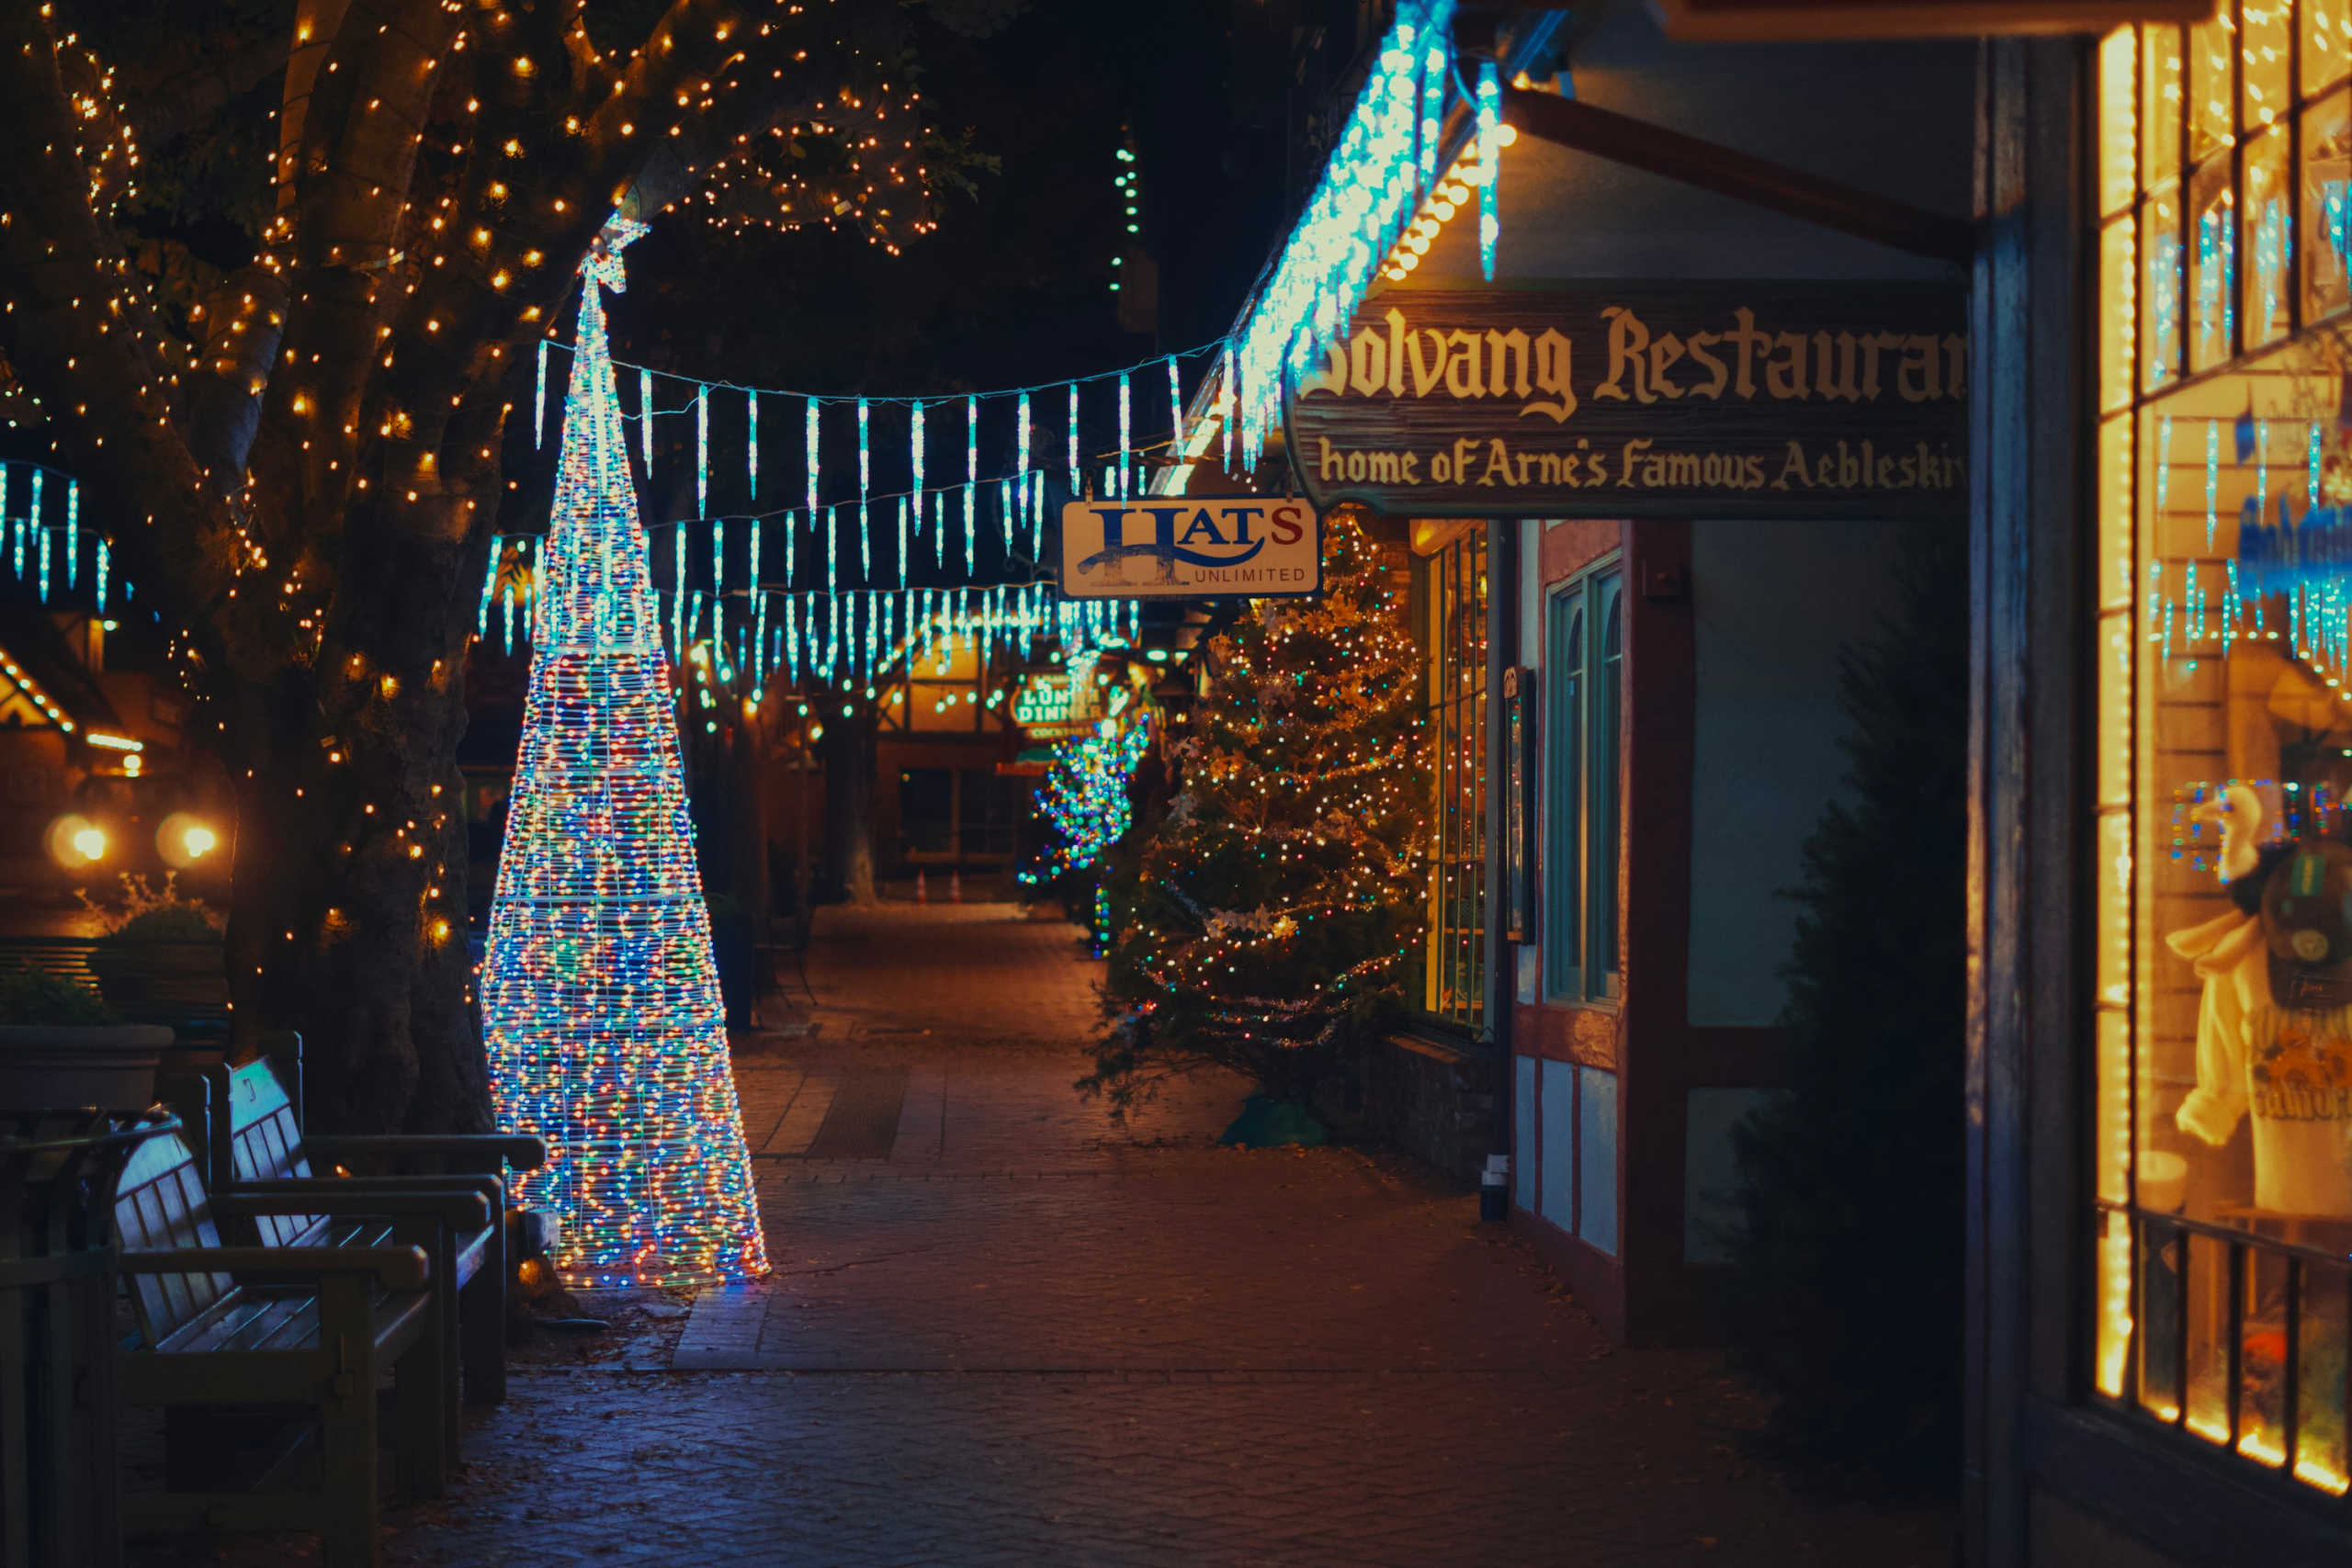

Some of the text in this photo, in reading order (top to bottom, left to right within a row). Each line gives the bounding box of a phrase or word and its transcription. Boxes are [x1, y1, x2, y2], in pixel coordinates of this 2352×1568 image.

[1318, 436, 1421, 487] home
[1430, 438, 1481, 486] of
[1477, 438, 1608, 489] Arne's
[1615, 438, 1765, 490] Famous
[1089, 506, 1303, 586] HATS
[1195, 568, 1305, 582] UNLIMITED
[1023, 689, 1100, 705] LUNH
